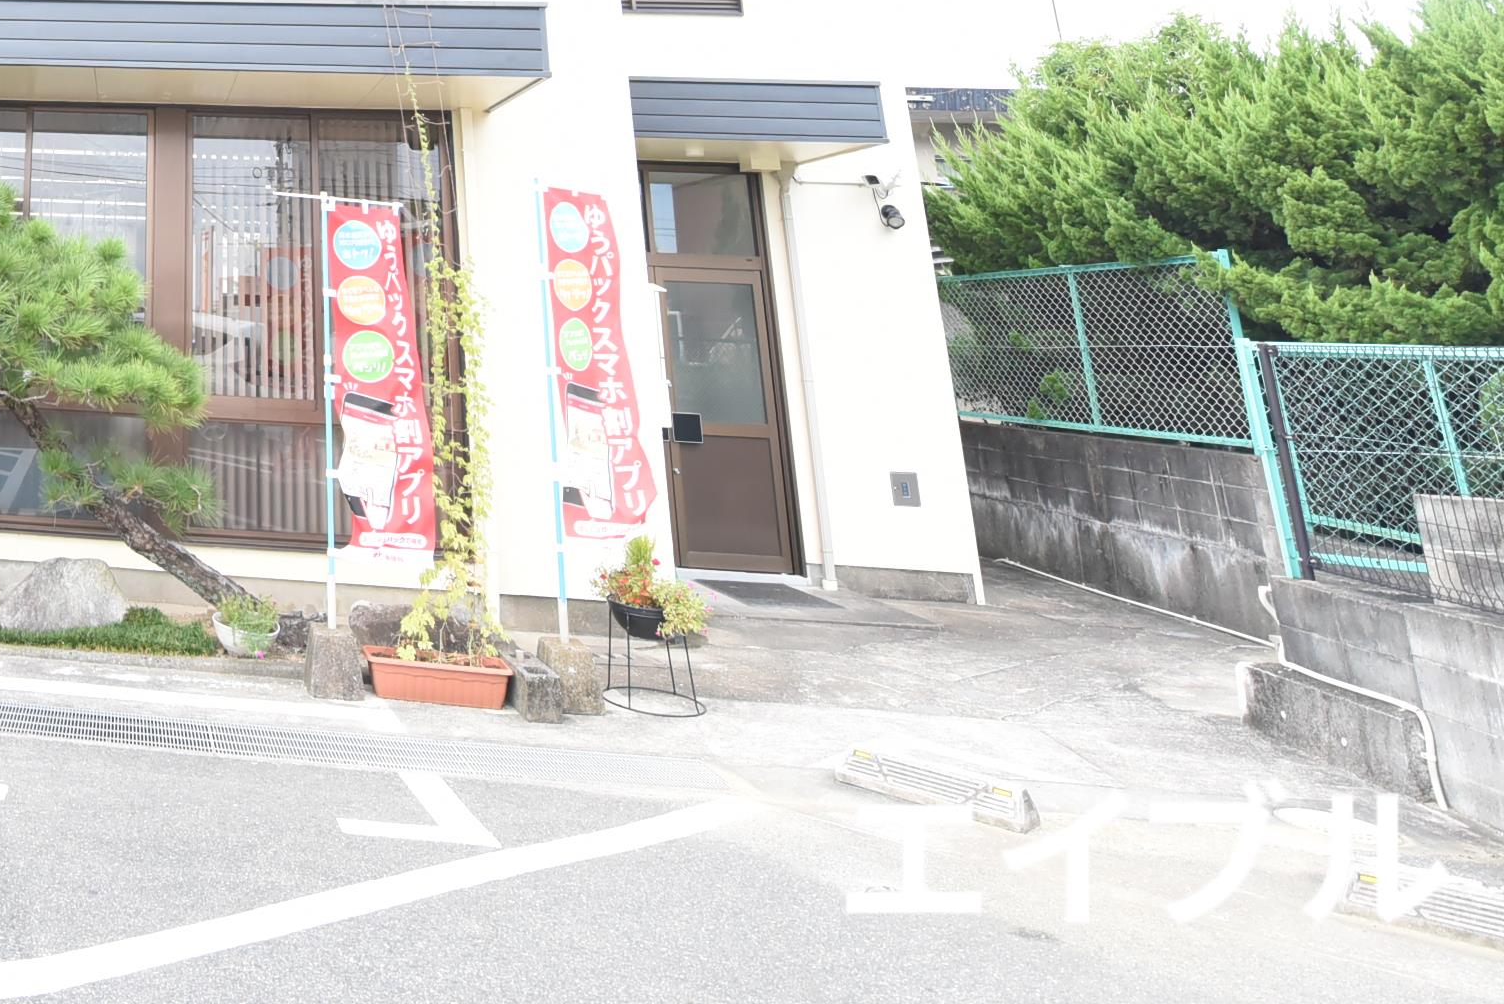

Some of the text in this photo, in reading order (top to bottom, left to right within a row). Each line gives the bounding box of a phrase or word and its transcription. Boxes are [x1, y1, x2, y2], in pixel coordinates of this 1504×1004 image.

[376, 219, 424, 525] ゆうパックスマホ割アプリ
[584, 203, 647, 517] ゆうパックスマホ割アプリ
